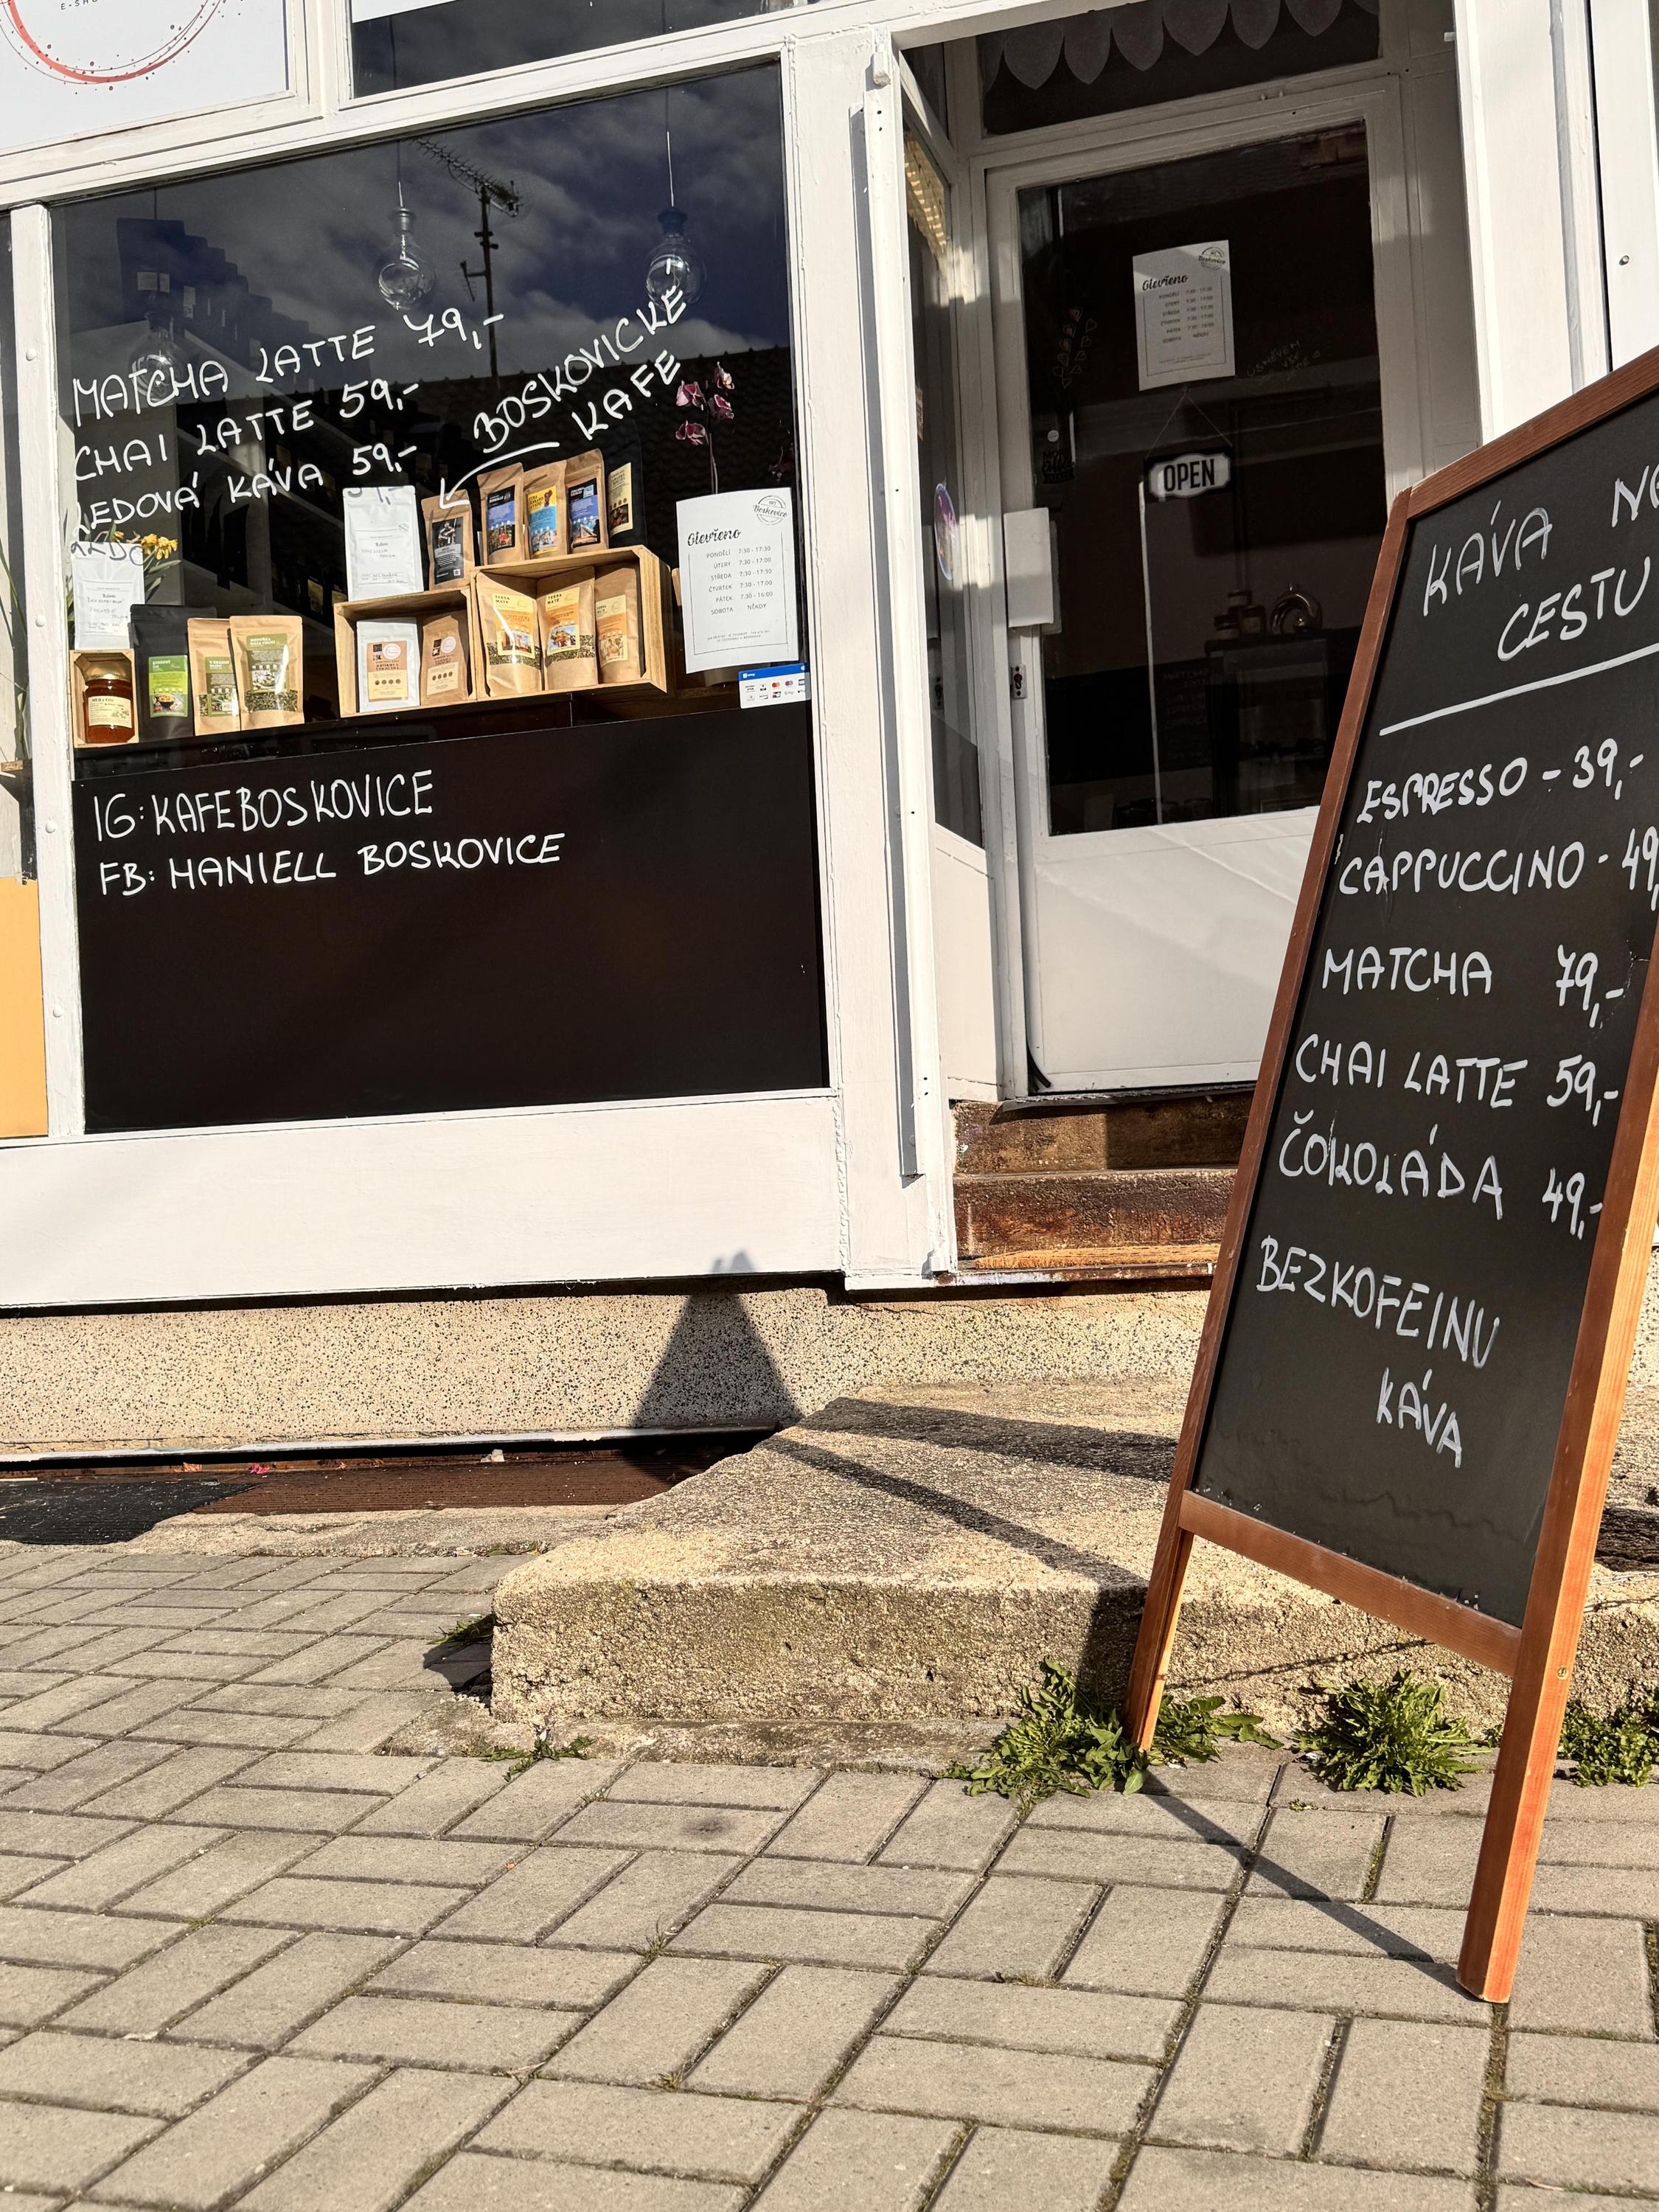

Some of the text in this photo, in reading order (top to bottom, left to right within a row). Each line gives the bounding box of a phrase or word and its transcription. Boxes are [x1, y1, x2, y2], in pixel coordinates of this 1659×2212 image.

[73, 307, 504, 427] MATCHA LATTE 79,-
[571, 349, 681, 441] KAFE
[74, 378, 420, 481] CHAI LATTE 59,-
[1164, 458, 1214, 493] OPEN
[72, 442, 417, 535] LEDOVÁ KÁVA 59,-
[687, 529, 742, 546] Otevřeno
[1423, 500, 1553, 616] KÁVA
[711, 607, 734, 615] SOBOTA
[1498, 556, 1650, 661] CESTU
[1357, 757, 1528, 824] ESPRESSO
[1573, 738, 1644, 801] 39,-
[99, 832, 566, 897] FB: HANIELL BOSKOVICE
[1338, 841, 1585, 895] CAPPUCCINO
[1321, 944, 1624, 1029] MATCHA 79,-
[1295, 1032, 1620, 1127] CHAI LATTE 59,-
[1279, 1110, 1604, 1241] ČOKOLÁDA 49,-
[1256, 1235, 1500, 1369] BEZKOFEINU
[1376, 1366, 1464, 1470] KÁVA
